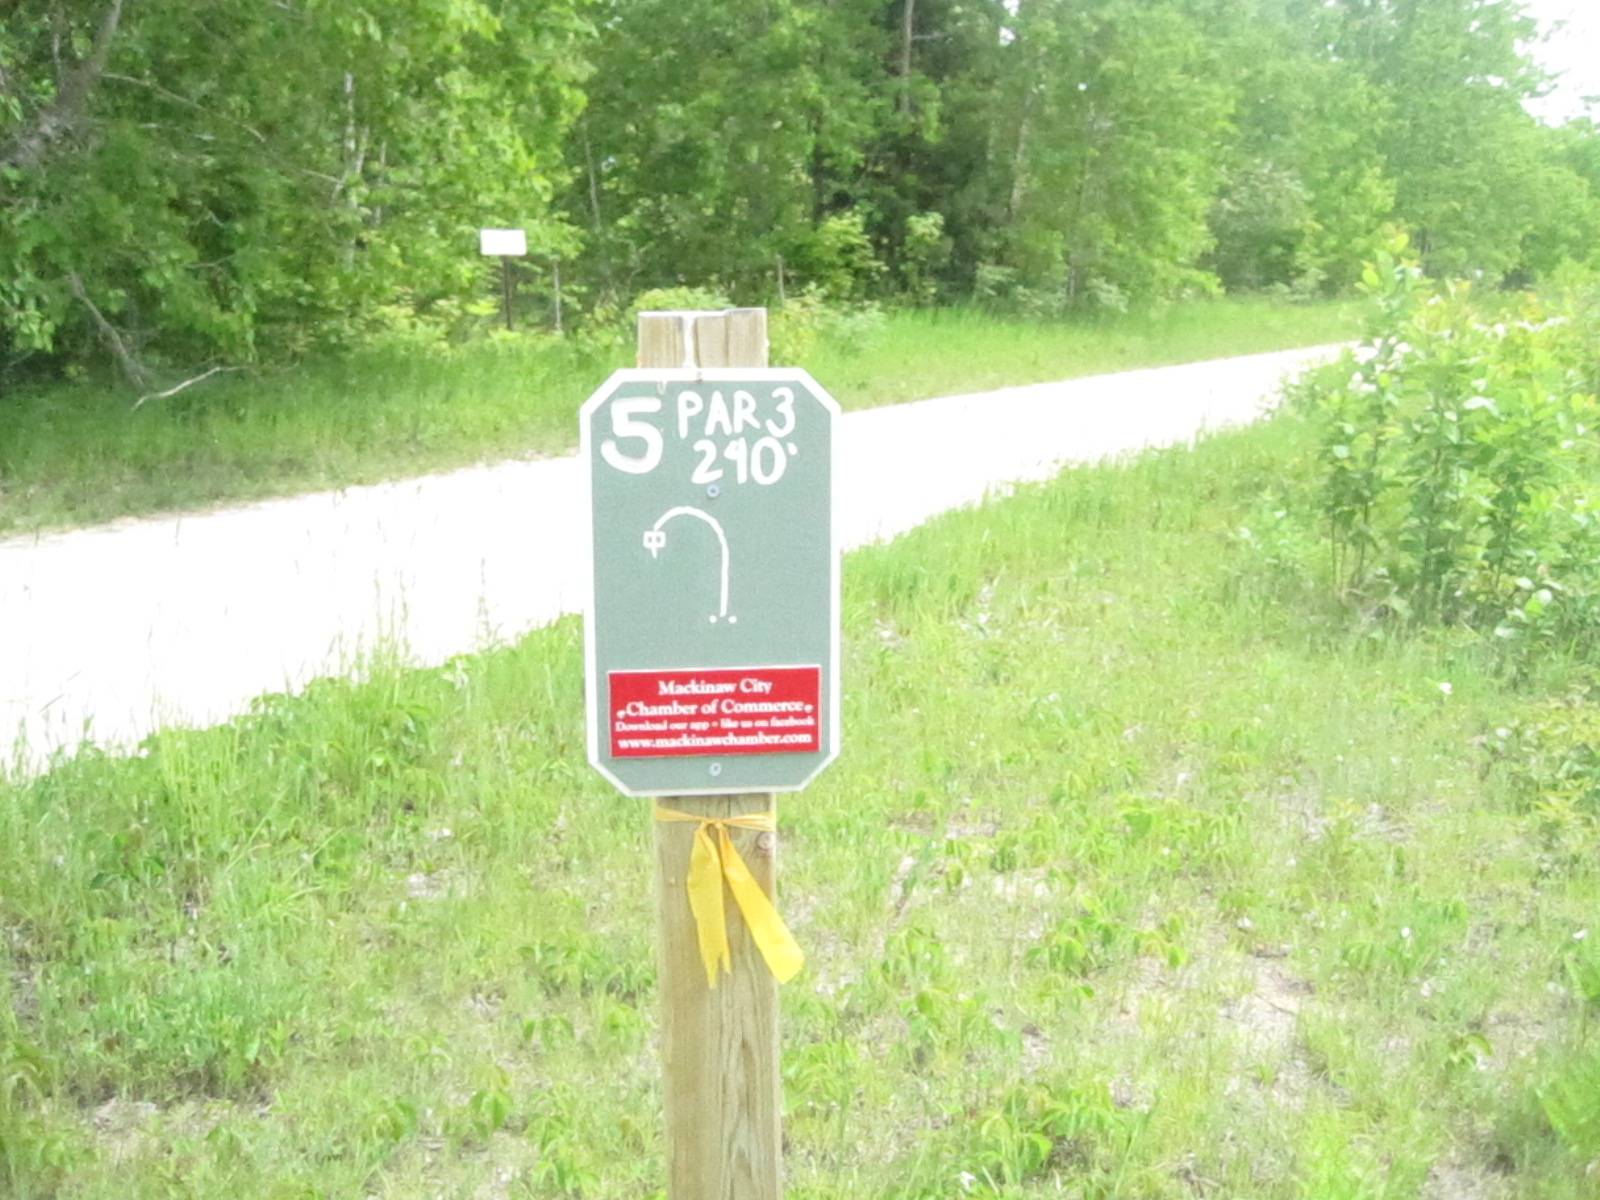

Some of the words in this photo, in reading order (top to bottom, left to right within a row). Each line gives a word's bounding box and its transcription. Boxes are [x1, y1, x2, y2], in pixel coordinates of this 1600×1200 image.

[677, 390, 760, 438] PAR
[765, 386, 796, 438] 3
[600, 396, 664, 474] 5
[658, 679, 736, 695] Mackinaw
[740, 678, 773, 695] City
[626, 700, 698, 717] Chamber
[701, 699, 719, 714] of
[720, 698, 804, 714] Commerce
[615, 720, 667, 732] Download
[720, 718, 738, 729] like
[740, 719, 753, 729] us
[770, 715, 815, 728] facebook
[618, 732, 812, 748] www.mackinawchamber.com
